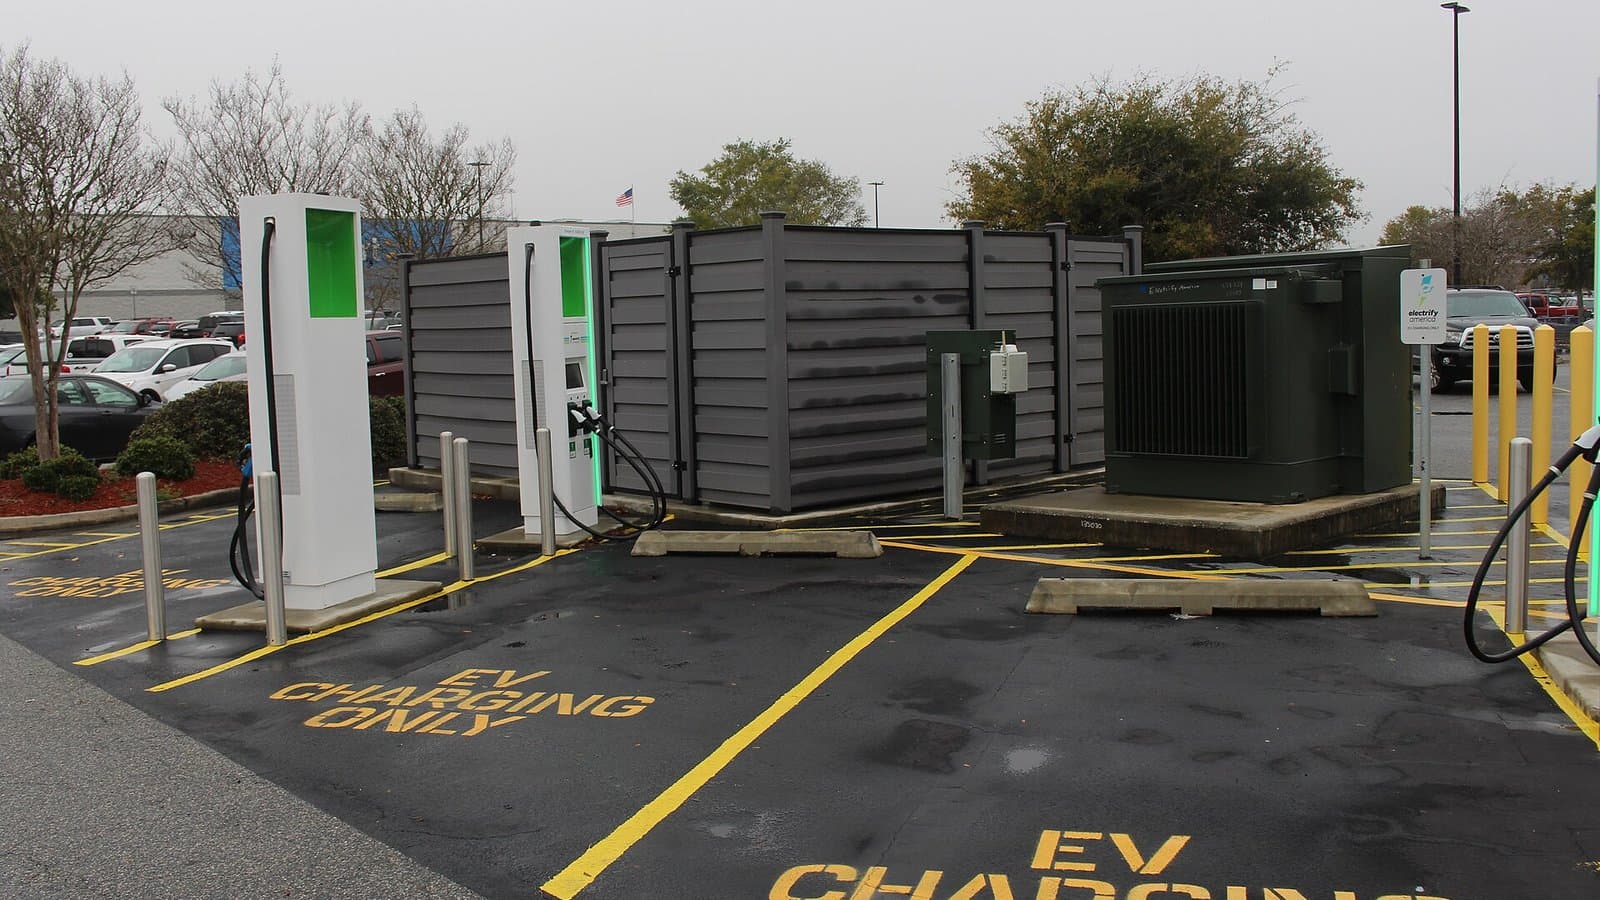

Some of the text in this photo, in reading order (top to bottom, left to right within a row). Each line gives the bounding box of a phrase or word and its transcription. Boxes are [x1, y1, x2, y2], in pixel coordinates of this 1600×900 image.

[1408, 309, 1439, 317] electrify
[438, 669, 552, 689] EV
[269, 682, 656, 718] CHARGING
[304, 706, 527, 737] ONLY
[1030, 829, 1191, 875] EV
